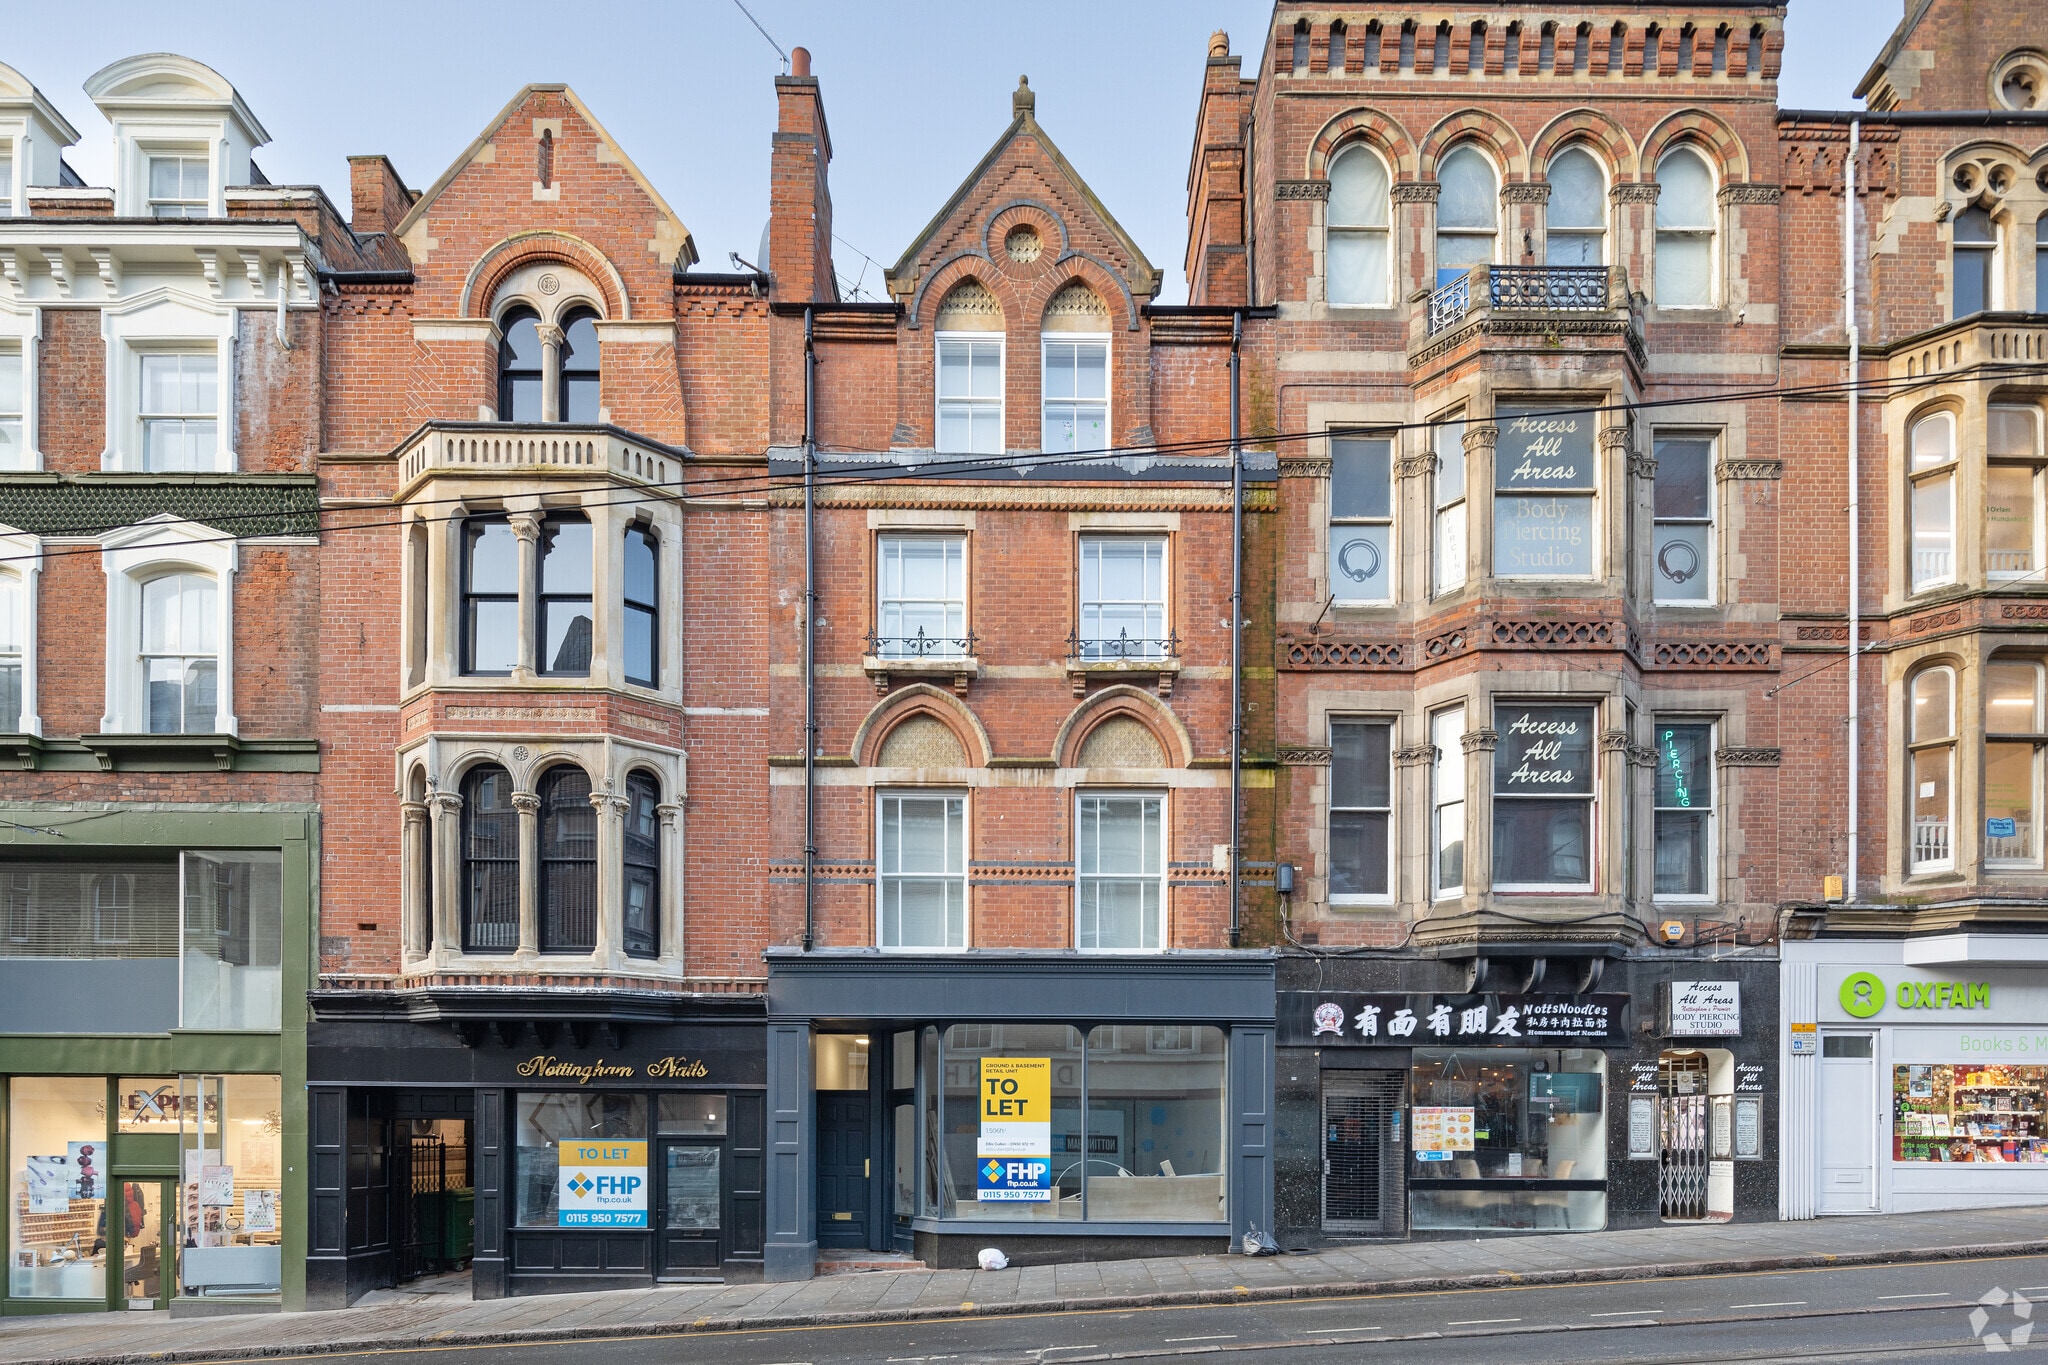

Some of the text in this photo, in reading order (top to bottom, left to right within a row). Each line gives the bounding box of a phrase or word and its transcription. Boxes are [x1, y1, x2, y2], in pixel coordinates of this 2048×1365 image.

[1508, 412, 1579, 435] Access
[1522, 436, 1563, 458] All
[1510, 458, 1577, 481] Areas
[1517, 497, 1570, 523] Body
[1503, 520, 1582, 546] Piercing
[1510, 546, 1574, 567] Studio
[1508, 713, 1579, 735] Access
[1521, 739, 1562, 762] All
[1507, 762, 1575, 784] Areas
[1665, 730, 1690, 807] PIERCING
[1689, 981, 1722, 992] Access
[1896, 981, 1990, 1009] OXFAM
[1678, 994, 1734, 1004] All Areas
[1522, 1003, 1608, 1016] NottsNoodles
[1673, 1013, 1740, 1021] BODY PIERCING
[1354, 1004, 1522, 1037] 有面有朋友
[1690, 1021, 1723, 1029] STUDIO
[1960, 1035, 2013, 1052] Books
[2018, 1036, 2029, 1052] &
[516, 1055, 709, 1085] Nottingham Nails
[1630, 1063, 1659, 1072] Access
[1736, 1063, 1764, 1072] Access
[1636, 1073, 1652, 1081] All
[1742, 1073, 1758, 1081] All
[986, 1078, 1019, 1095] TO
[1631, 1082, 1658, 1090] Areas
[1736, 1082, 1763, 1090] Areas
[986, 1099, 1029, 1116] LET
[577, 1148, 630, 1160] TO LET
[1006, 1162, 1047, 1180] FHP
[596, 1176, 642, 1195] FHP
[1007, 1180, 1039, 1188] fhp.co.uk
[596, 1196, 633, 1205] fhp.co.uk
[983, 1191, 1045, 1199] 0115 950 7577
[566, 1213, 642, 1223] 0115 950 7577
